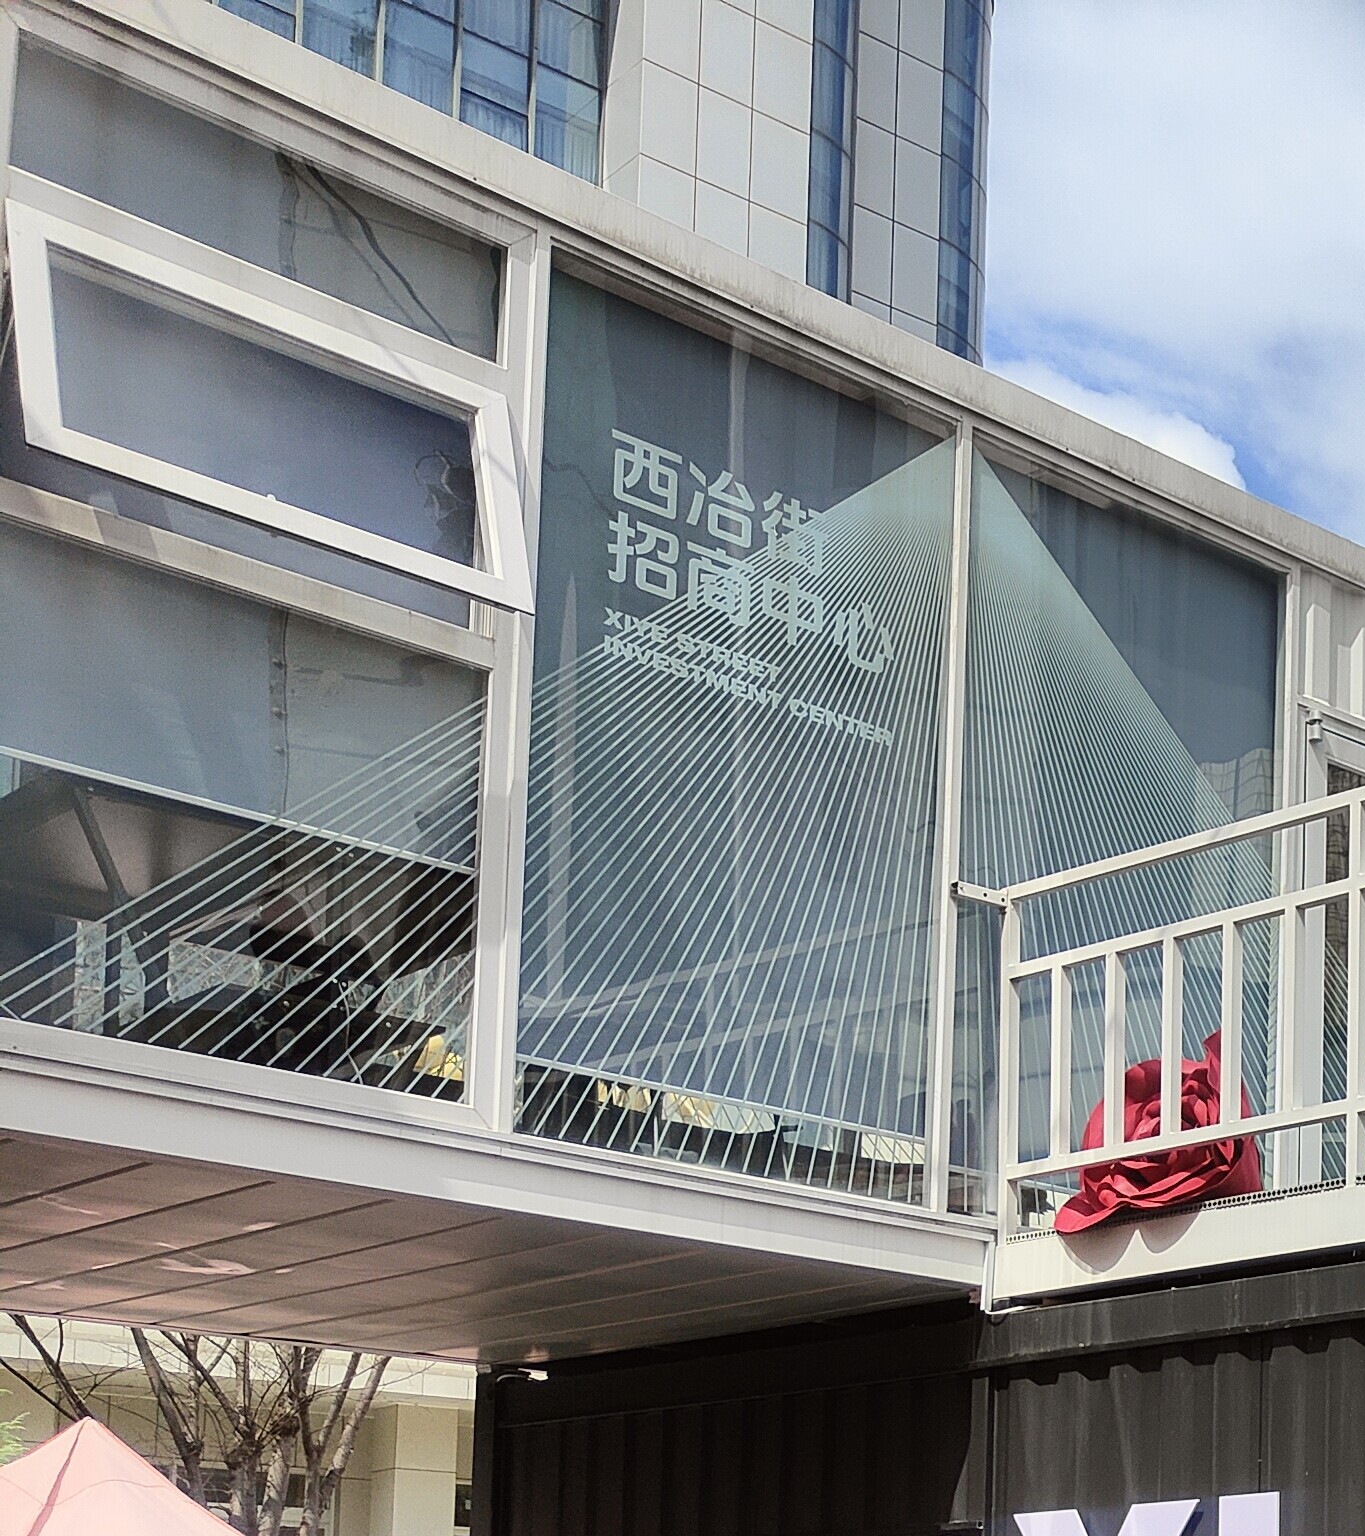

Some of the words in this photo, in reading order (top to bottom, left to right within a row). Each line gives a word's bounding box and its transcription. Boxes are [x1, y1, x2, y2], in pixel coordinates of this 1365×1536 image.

[603, 606, 669, 644] XIYE
[677, 632, 781, 683] STREET
[606, 509, 895, 675] 招商中心
[603, 634, 783, 710] INVESTMENT
[790, 698, 893, 748] CENTER
